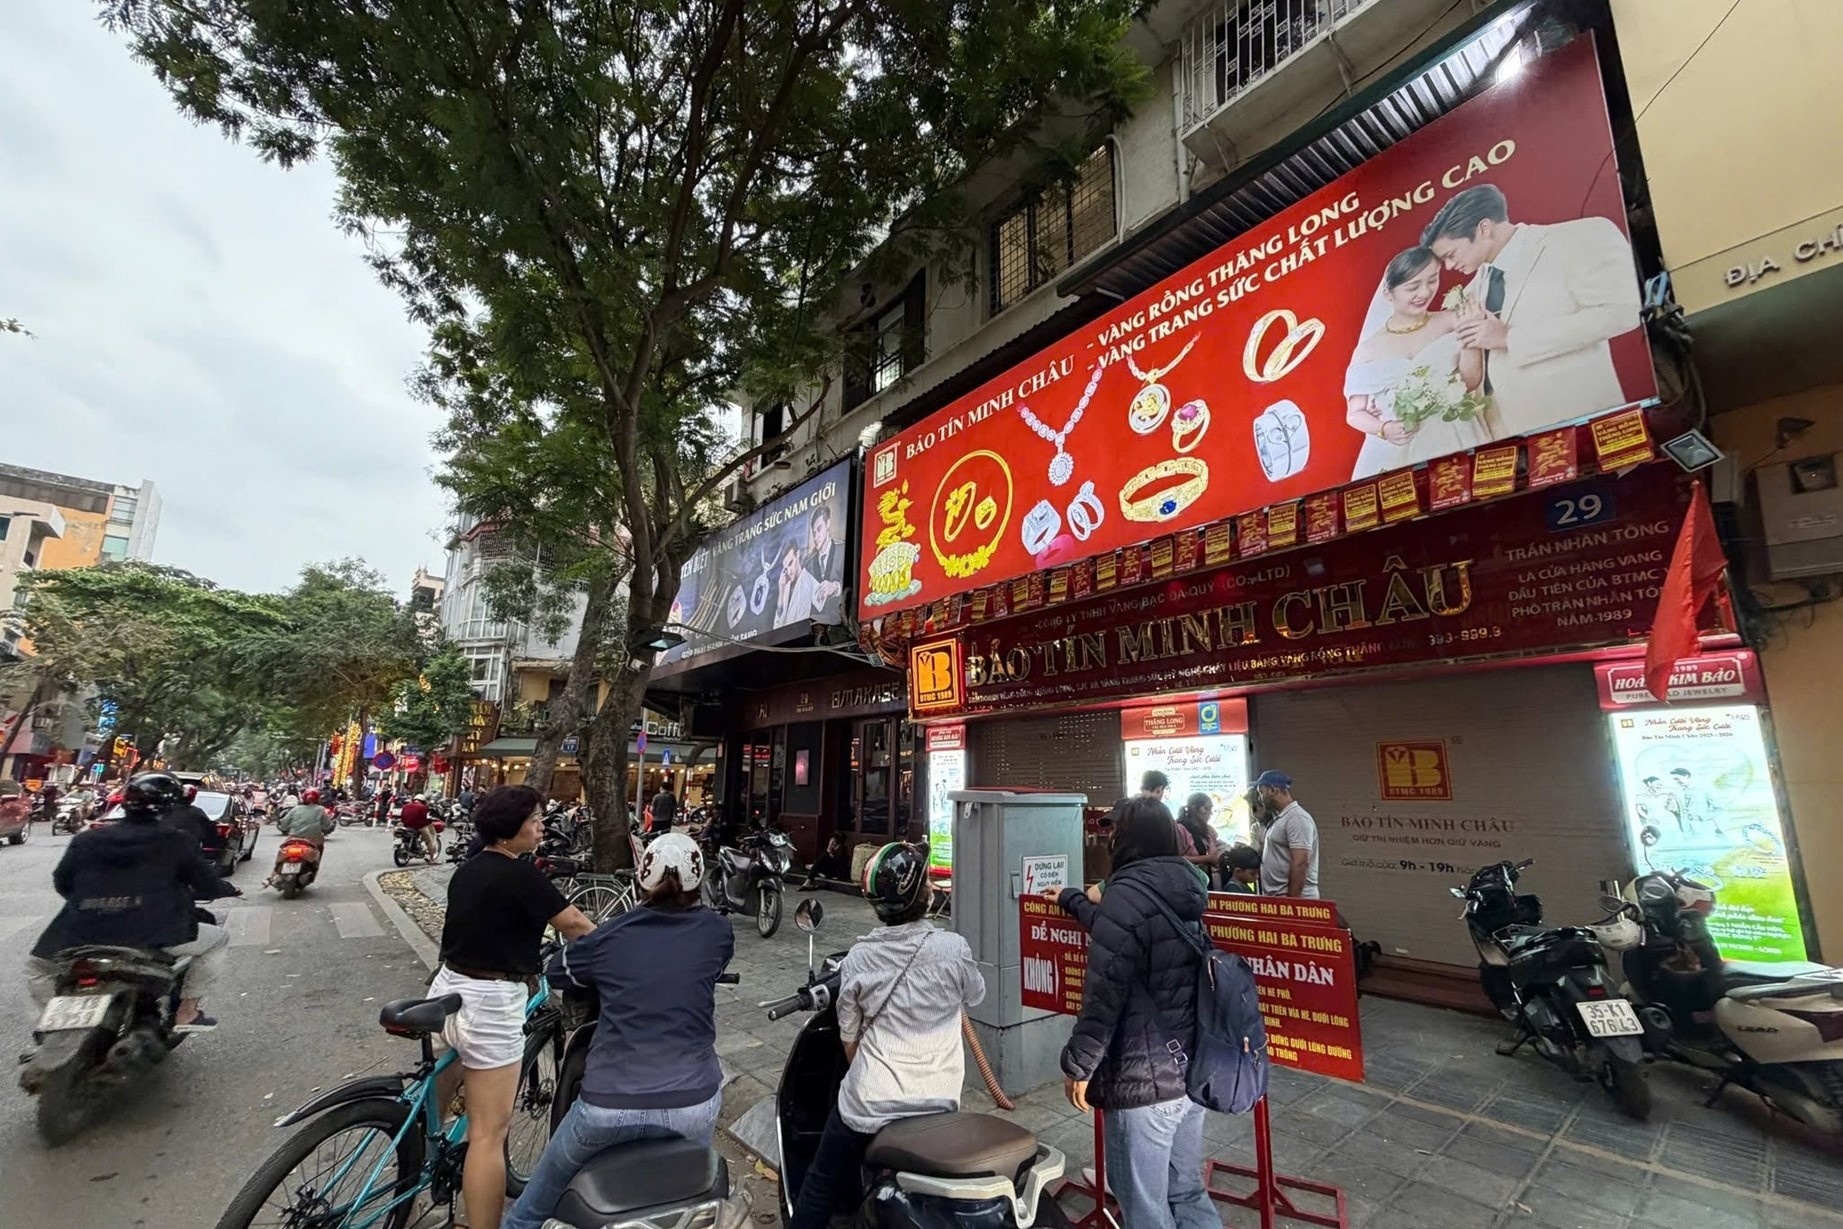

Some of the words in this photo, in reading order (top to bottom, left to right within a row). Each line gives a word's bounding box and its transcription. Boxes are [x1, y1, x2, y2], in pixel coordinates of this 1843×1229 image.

[1097, 333, 1146, 369] VÀNG
[1148, 298, 1214, 344] TRANG
[1216, 271, 1261, 309] SỨC
[1263, 235, 1329, 283] CHẤT
[1333, 180, 1435, 249] LƯỢNG
[1441, 139, 1517, 189] CAO
[1098, 310, 1146, 347] VÀNG
[1148, 278, 1205, 321] RỒNG
[1207, 234, 1284, 287] THĂNG
[1287, 191, 1361, 246] LONG
[906, 434, 936, 460] BẢO
[938, 419, 964, 443] TÍN
[967, 388, 1014, 428] MINH
[1018, 354, 1075, 399] CHÂU
[735, 521, 763, 546] TRANG
[764, 510, 783, 531] SỨC
[784, 499, 808, 521] NAM
[810, 482, 836, 507] GIỚI
[1554, 494, 1603, 525] 29
[1612, 568, 1660, 586] BTMC
[1635, 586, 1664, 600] TÔ
[966, 637, 1031, 688] BẢO
[1039, 624, 1107, 677] TÍN
[1115, 600, 1261, 665] MINH
[1271, 554, 1475, 640] CHÂU
[1614, 674, 1647, 690] HOÀ
[1668, 671, 1698, 687] KIM
[1701, 667, 1737, 684] BẢO
[831, 681, 900, 709] OMAKASE
[937, 689, 953, 700] 1989
[646, 721, 683, 738] Coff
[1376, 814, 1404, 829] TÍN
[1407, 816, 1456, 831] MINH
[1460, 817, 1515, 833] CHÂU
[1400, 860, 1417, 871] 9h
[1429, 862, 1455, 873] 19h
[1024, 901, 1047, 915] CÔNG
[1260, 903, 1277, 915] HAI
[1296, 905, 1331, 920] TRƯNG
[1050, 927, 1083, 949] NGHỊ
[1258, 929, 1278, 945] HAI
[1300, 934, 1343, 953] TRƯNG
[1024, 952, 1054, 995] KHÔNG
[1294, 960, 1334, 986] DÂN
